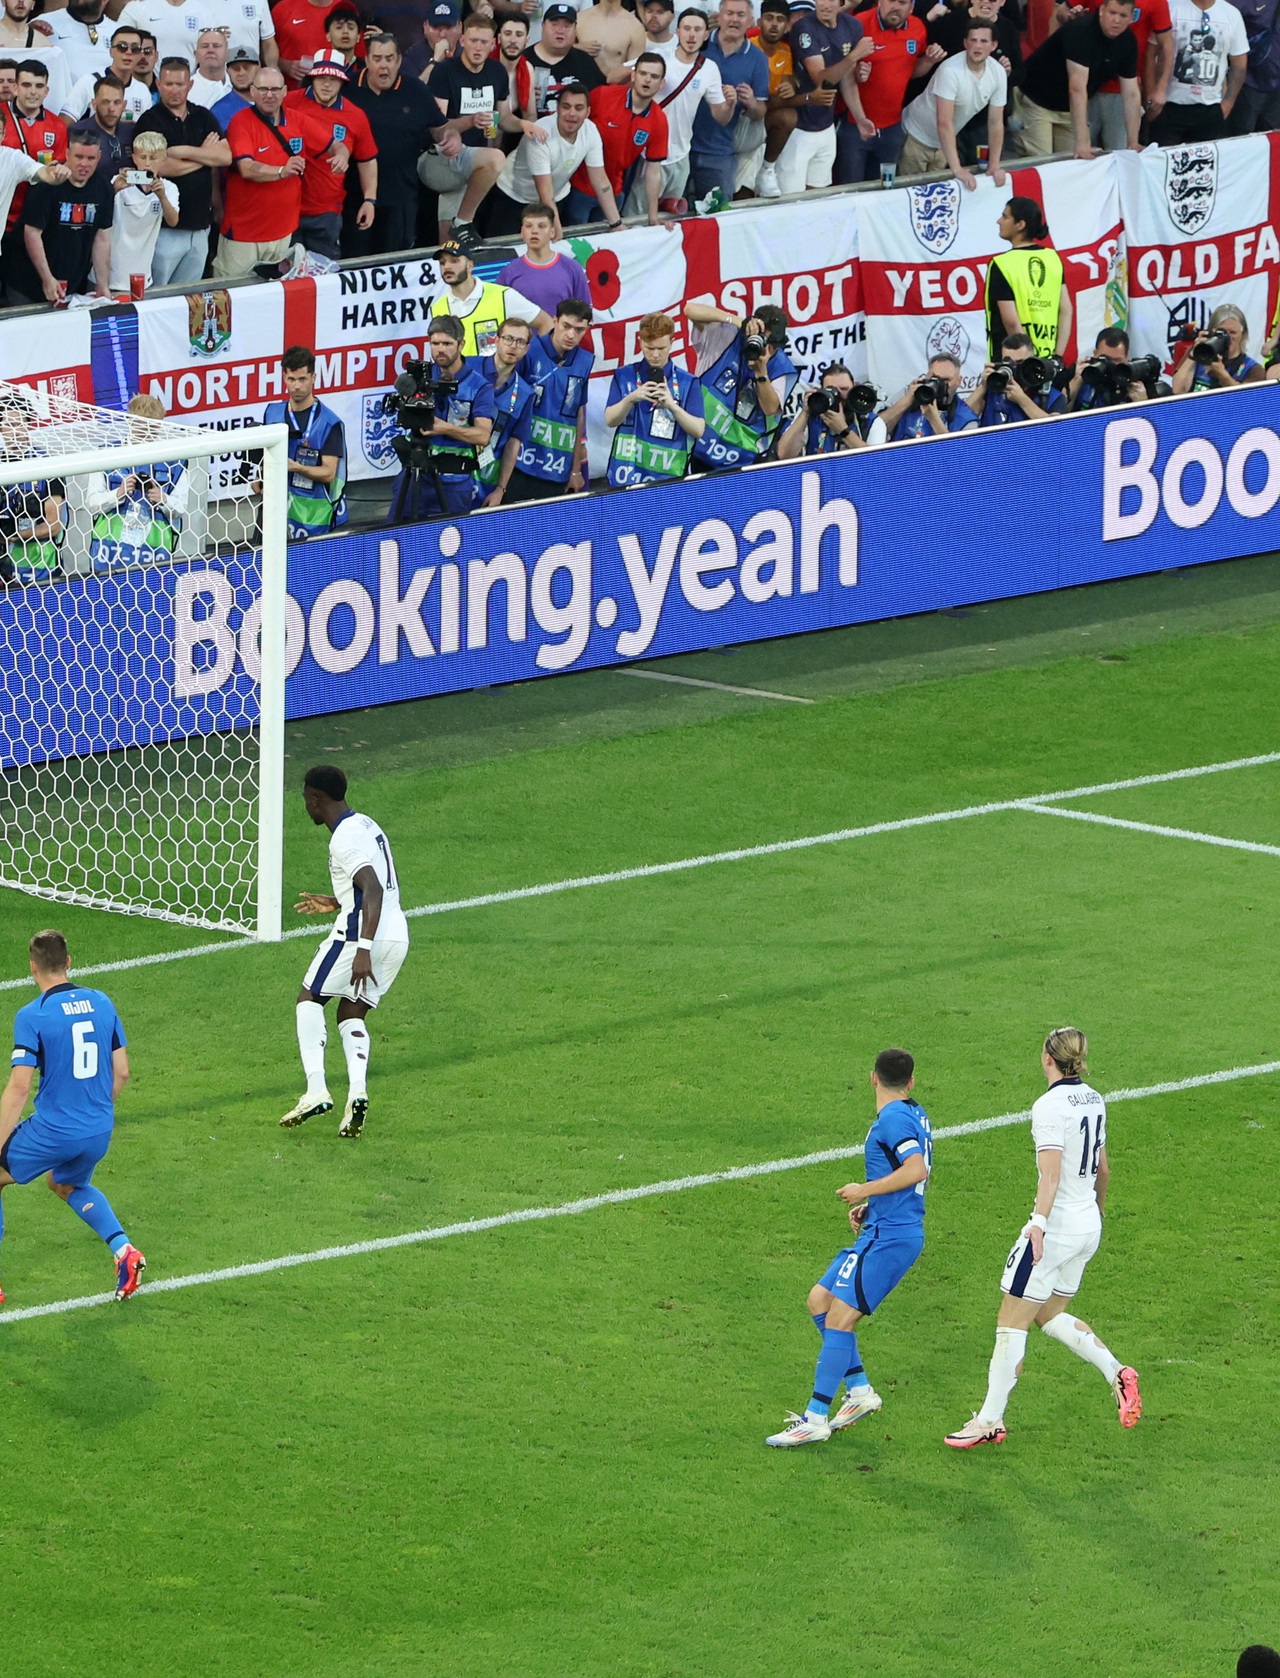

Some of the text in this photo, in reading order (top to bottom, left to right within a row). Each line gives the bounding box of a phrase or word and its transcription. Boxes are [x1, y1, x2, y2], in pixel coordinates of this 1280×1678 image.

[1198, 59, 1217, 79] 10
[463, 100, 493, 110] ENGLAND
[339, 262, 437, 296] NICK &
[1136, 243, 1220, 292] OLD
[341, 296, 435, 330] HARRY
[794, 333, 823, 356] OF
[149, 340, 433, 413] NORTHMPTO
[649, 448, 677, 471] TV
[1102, 416, 1280, 543] Boo
[175, 470, 859, 699] Booking.yeah
[61, 999, 95, 1016] BIJOL
[72, 1020, 99, 1080] 6
